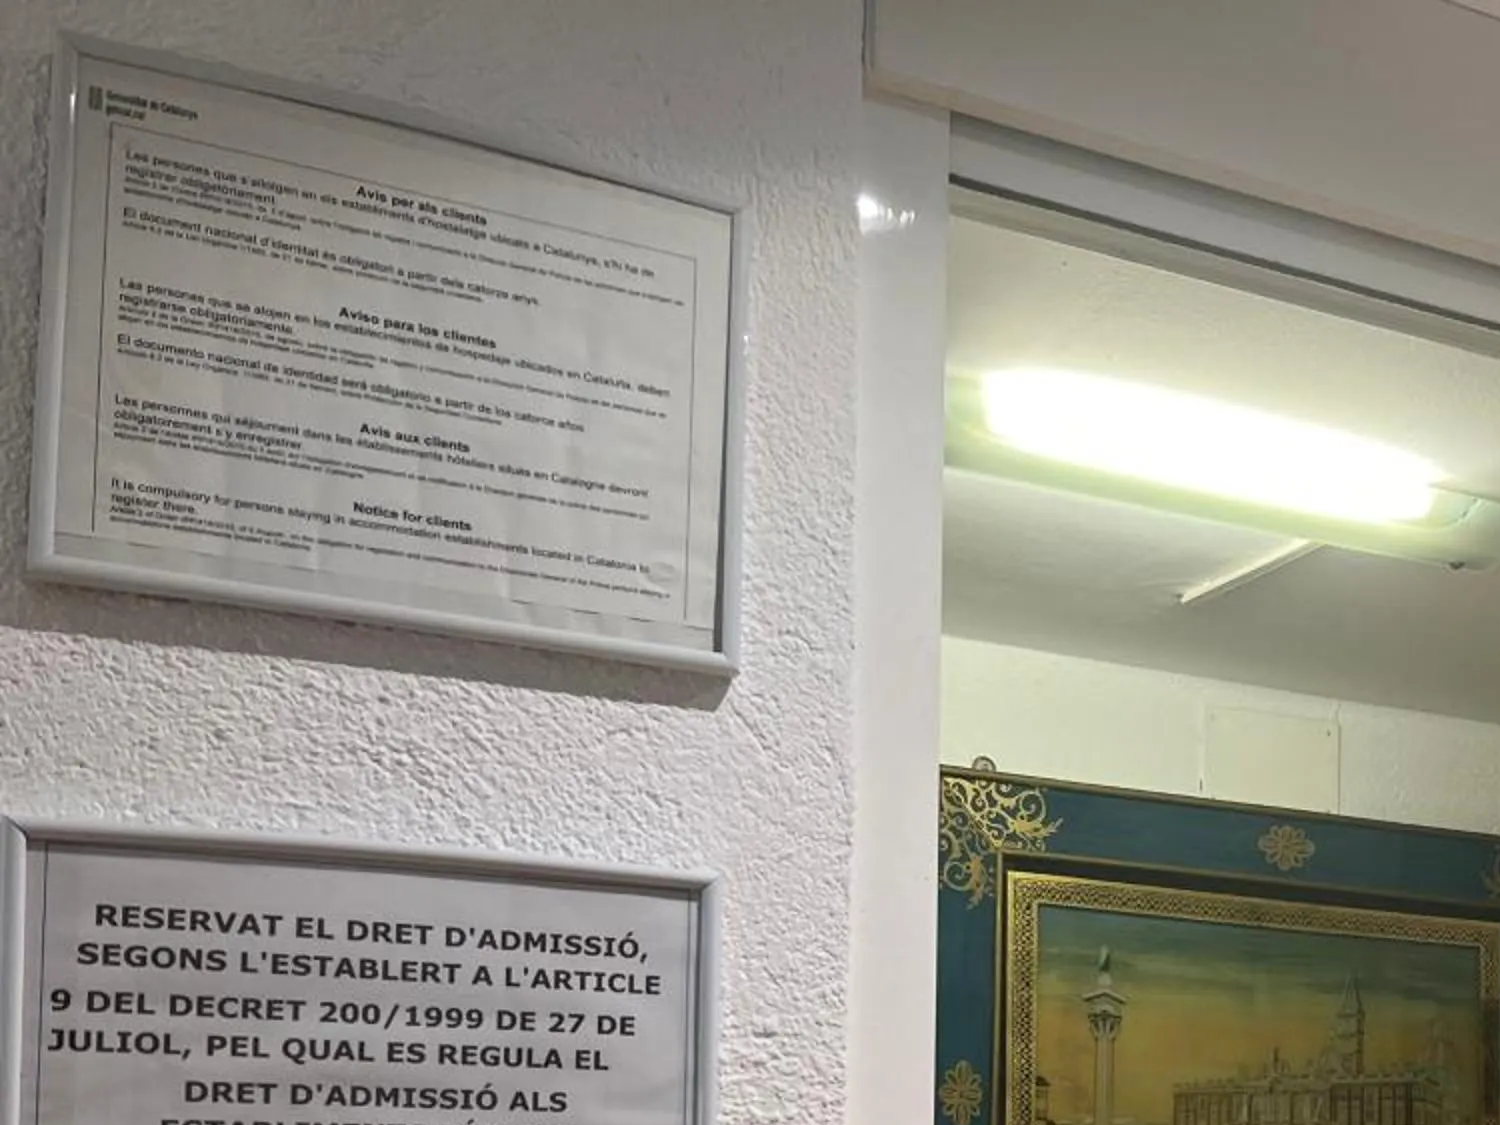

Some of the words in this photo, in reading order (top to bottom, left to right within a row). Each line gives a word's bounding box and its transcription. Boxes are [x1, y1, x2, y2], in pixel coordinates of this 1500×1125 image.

[356, 185, 388, 204] Avis
[391, 196, 415, 210] per
[418, 201, 438, 215] als
[441, 207, 488, 227] clients
[338, 306, 380, 325] Aviso
[383, 318, 415, 333] para
[418, 322, 440, 338] los
[443, 329, 497, 349] clientes
[359, 423, 391, 439] Avis
[394, 431, 421, 444] aux
[423, 436, 471, 453] clients
[353, 501, 399, 520] Notice
[402, 509, 423, 523] for
[425, 515, 473, 532] clients
[95, 903, 284, 937] RESERVAT
[295, 916, 335, 941] EL
[346, 919, 434, 946] DRET
[445, 926, 648, 965] D'ADMISSIÓ,
[76, 942, 227, 972] SEGONS
[240, 951, 462, 985] L'ESTABLERT
[471, 965, 493, 987] A
[504, 966, 661, 996] L'ARTICLE
[50, 988, 72, 1012] 9
[86, 989, 156, 1016] DEL
[169, 993, 307, 1022] DECRET
[319, 1001, 484, 1030] 200/1999
[496, 1009, 537, 1032] DE
[548, 1011, 586, 1034] 27
[596, 1014, 636, 1037] DE
[47, 1027, 191, 1061] JULIOL,
[206, 1034, 270, 1059] PEL
[281, 1037, 375, 1066] QUAL
[386, 1041, 426, 1065] ES
[437, 1043, 563, 1070] REGULA
[574, 1049, 610, 1071] EL
[184, 1080, 279, 1105] DRET
[290, 1082, 499, 1111] D'ADMISSIÓ
[508, 1090, 568, 1113] ALS
